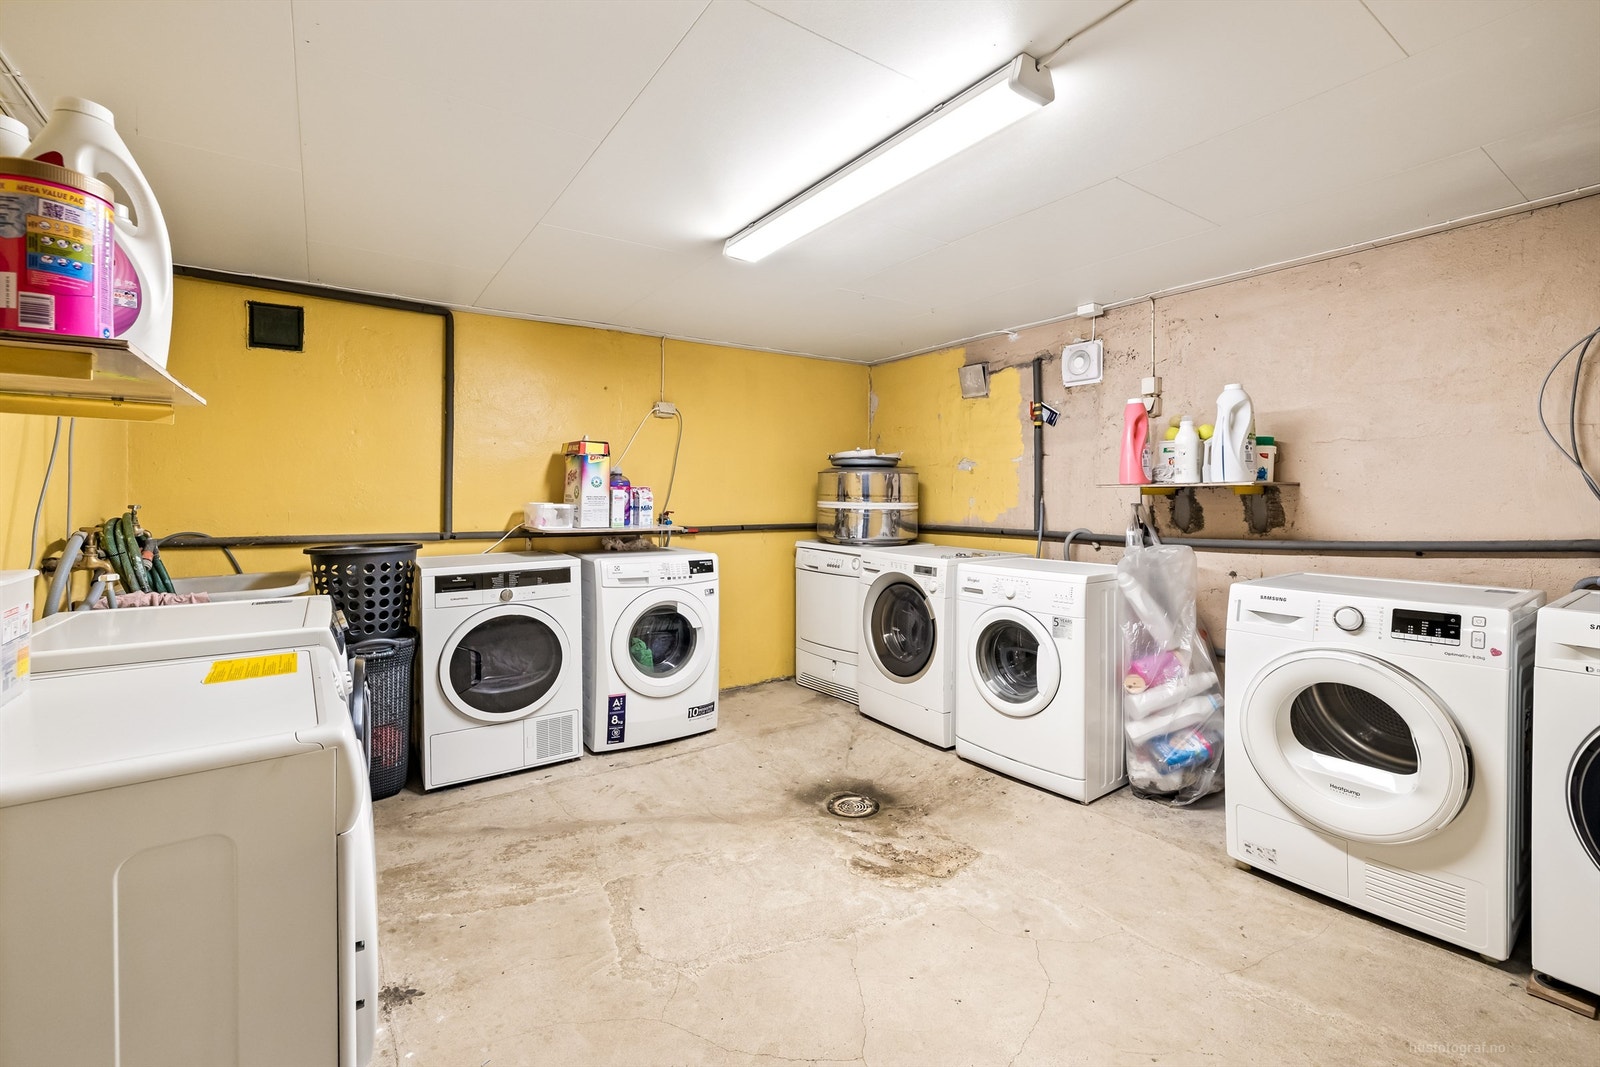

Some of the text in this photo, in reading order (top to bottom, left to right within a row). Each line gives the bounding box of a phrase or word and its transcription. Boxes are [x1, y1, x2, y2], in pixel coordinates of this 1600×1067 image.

[17, 184, 40, 194] MEGA
[42, 188, 67, 200] VALUE
[1053, 617, 1059, 626] 5
[690, 707, 698, 718] 10
[1330, 784, 1360, 796] Heatpump
